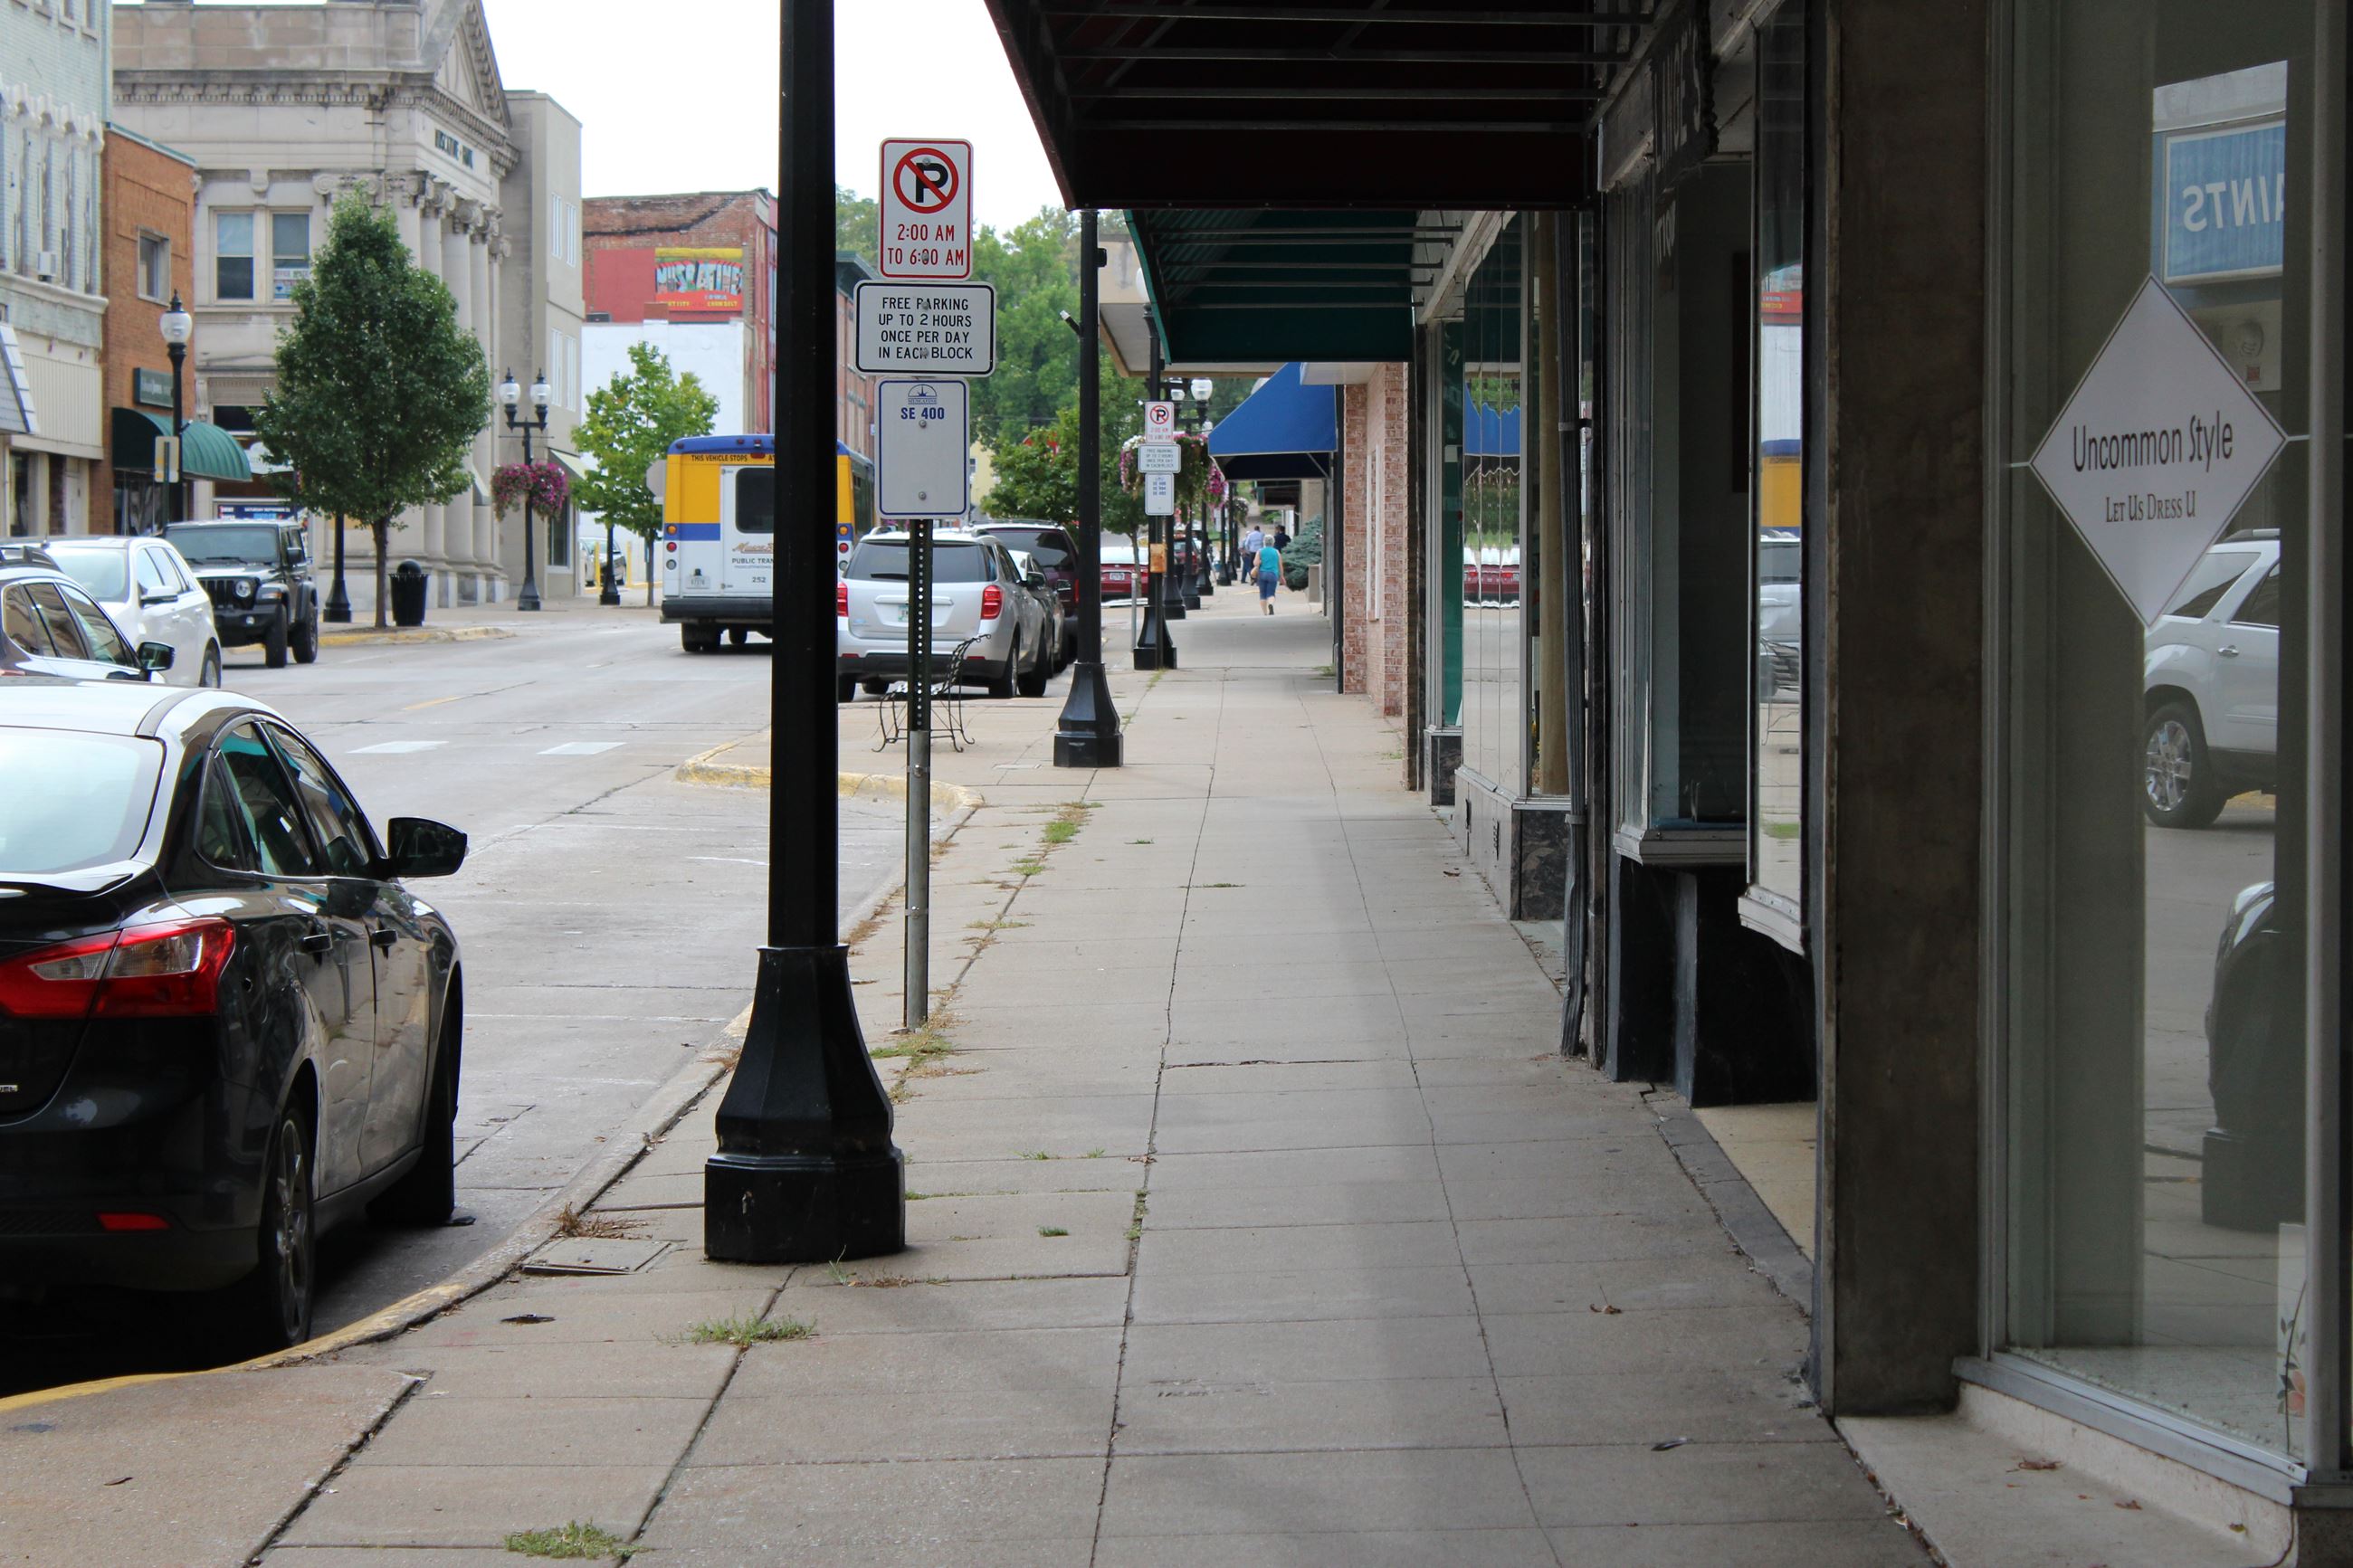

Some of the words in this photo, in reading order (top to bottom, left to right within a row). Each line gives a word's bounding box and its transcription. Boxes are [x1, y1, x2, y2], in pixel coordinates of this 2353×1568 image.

[898, 224, 929, 241] 2:00
[935, 225, 955, 242] AM
[888, 248, 903, 264] TO
[910, 249, 938, 265] 6:00
[946, 249, 964, 266] AM
[882, 297, 910, 309] FREE
[917, 298, 968, 310] PARKING
[879, 314, 893, 326] UP
[900, 314, 914, 326] TO
[919, 313, 929, 326] 2
[933, 315, 972, 327] HOURS
[881, 330, 911, 342] ONCE
[917, 331, 939, 343] PER
[945, 331, 969, 344] DAY
[879, 347, 890, 358] IN
[931, 347, 973, 359] BLOCK
[900, 407, 916, 420] SE
[921, 407, 945, 420] 400
[2073, 425, 2182, 472] Uncommon
[2189, 410, 2233, 472] Style
[2186, 490, 2196, 518] U
